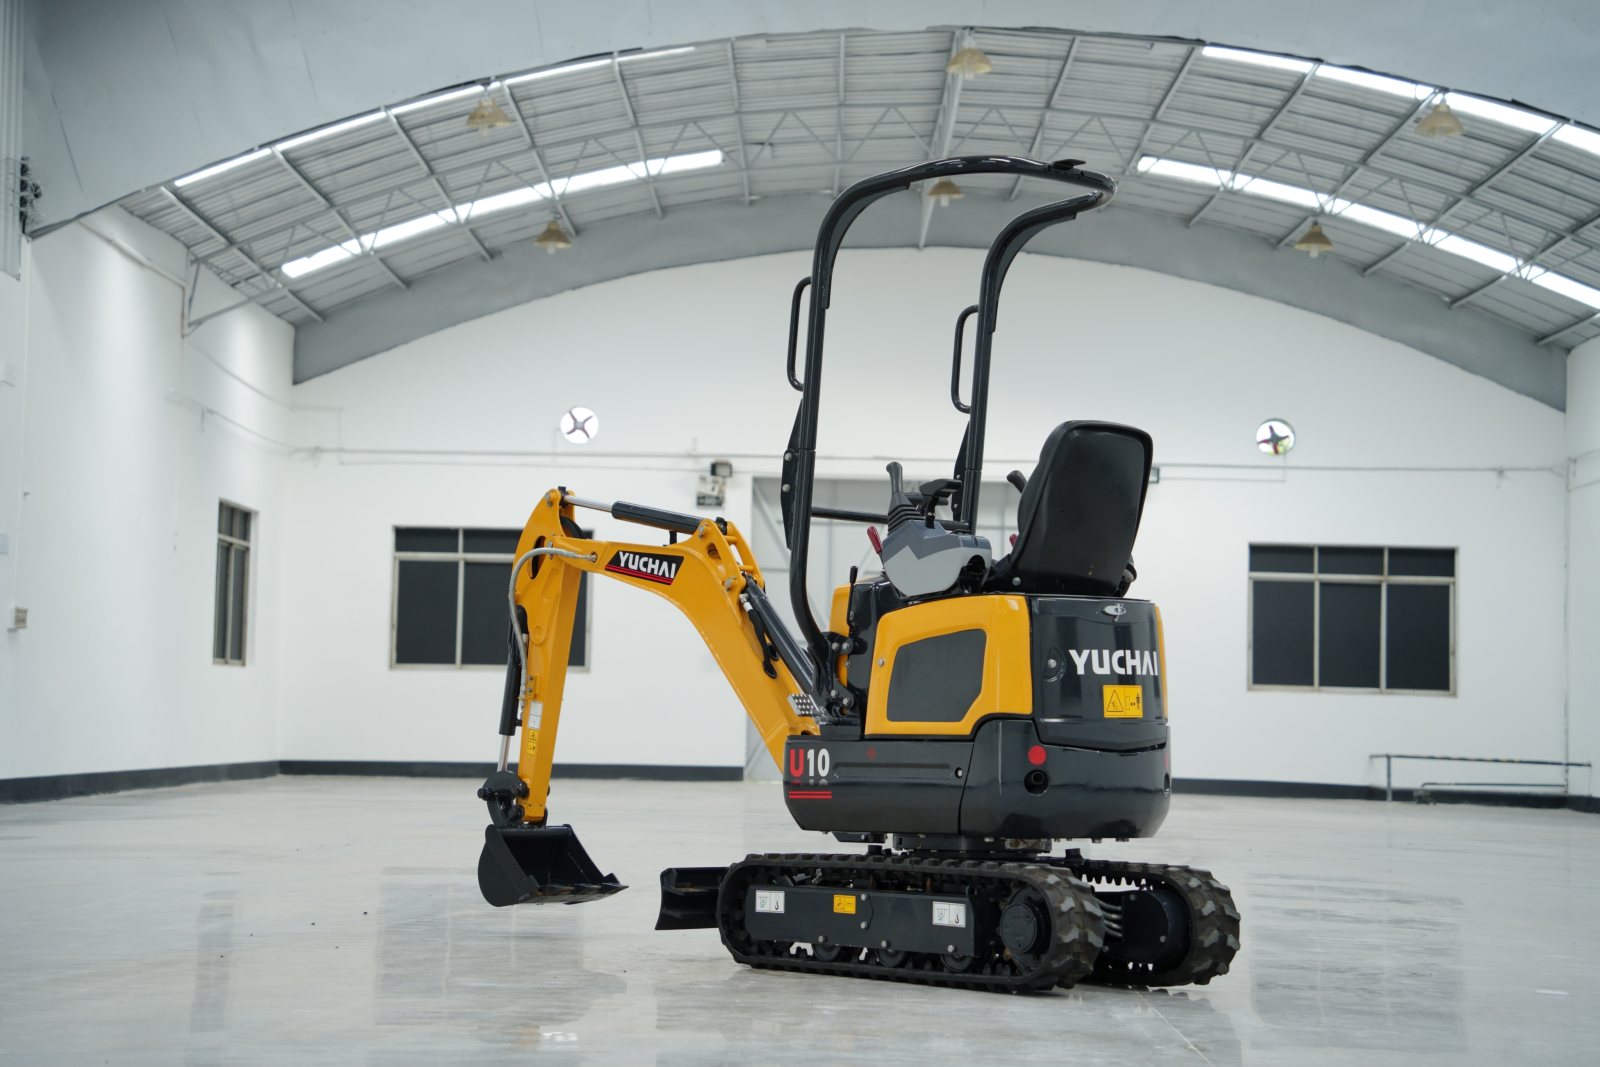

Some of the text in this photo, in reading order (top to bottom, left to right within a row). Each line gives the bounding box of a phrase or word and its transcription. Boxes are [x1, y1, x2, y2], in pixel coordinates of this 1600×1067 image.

[619, 551, 676, 578] YUCHAI
[1069, 650, 1159, 676] YUCHAI
[789, 748, 830, 777] U10
